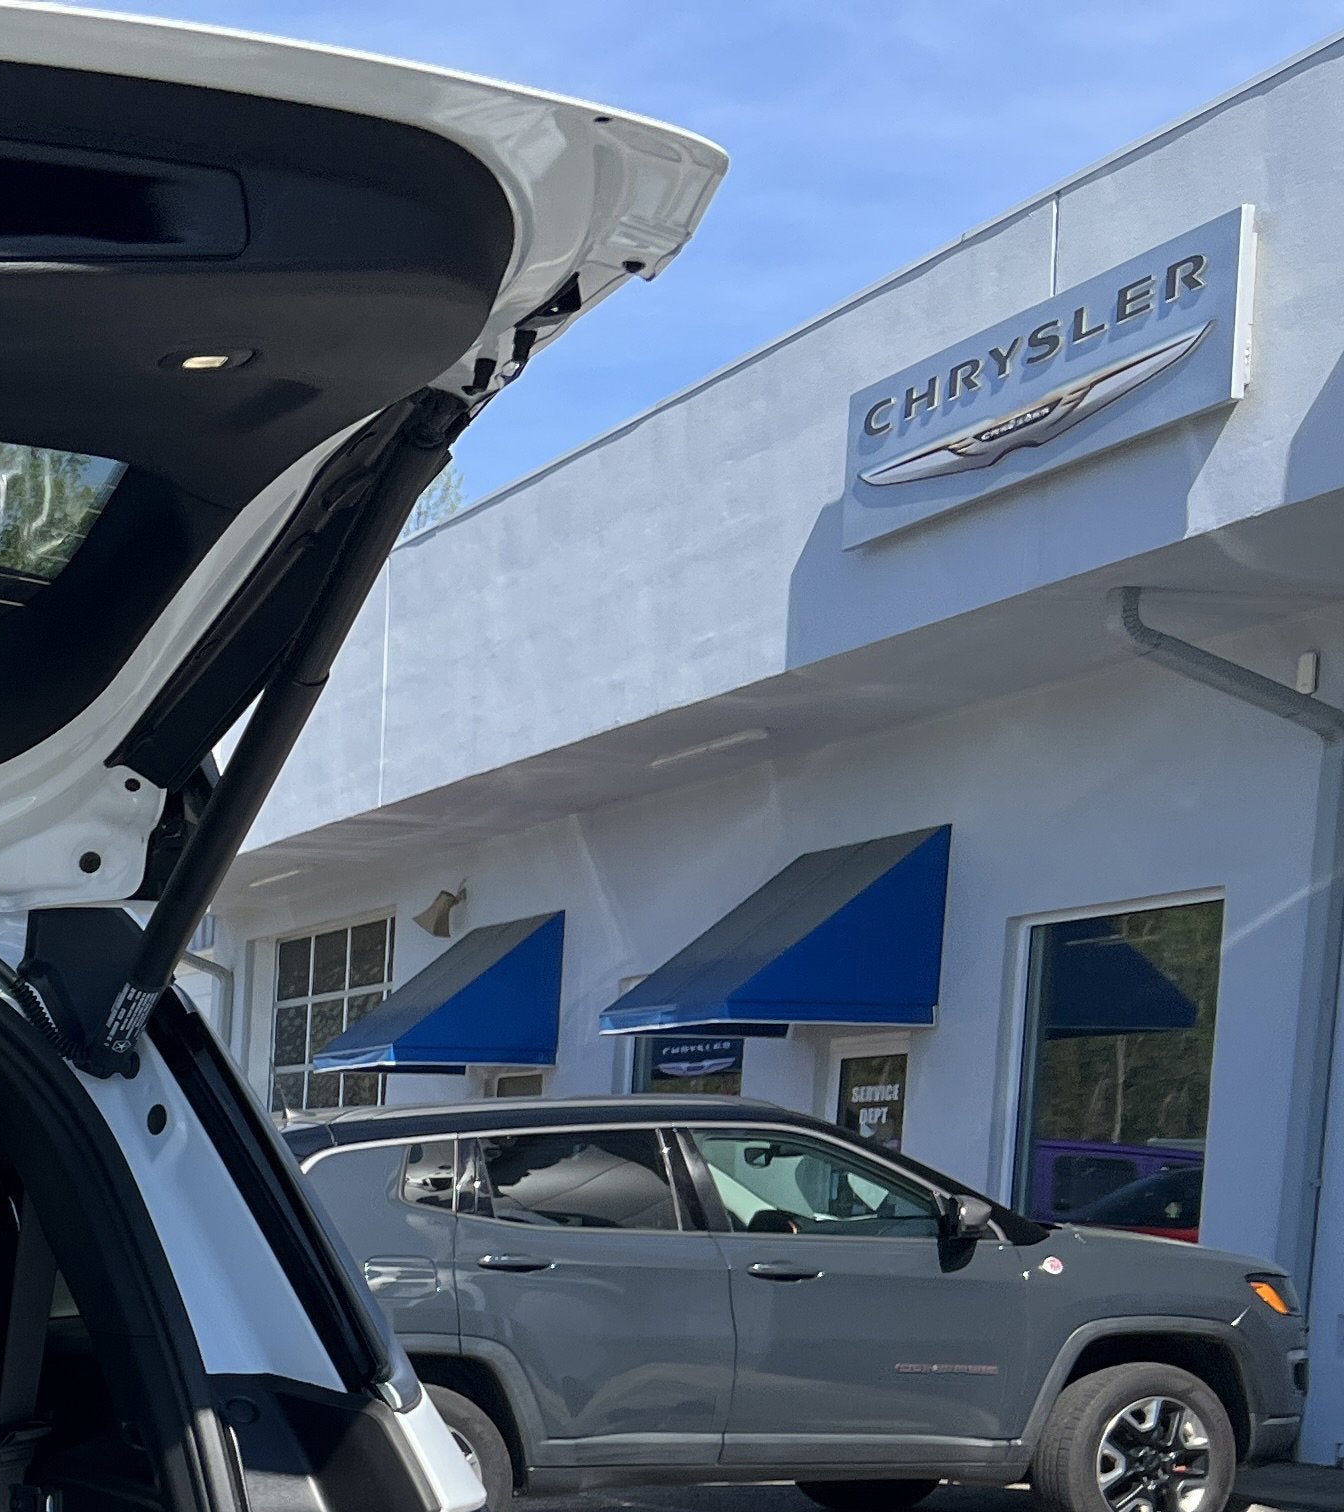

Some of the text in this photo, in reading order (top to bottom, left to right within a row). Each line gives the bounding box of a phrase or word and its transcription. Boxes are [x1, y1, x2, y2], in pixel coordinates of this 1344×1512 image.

[864, 254, 1208, 437] CHRYSLER
[852, 1084, 900, 1103] SERVICE
[859, 1106, 889, 1124] DEPT
